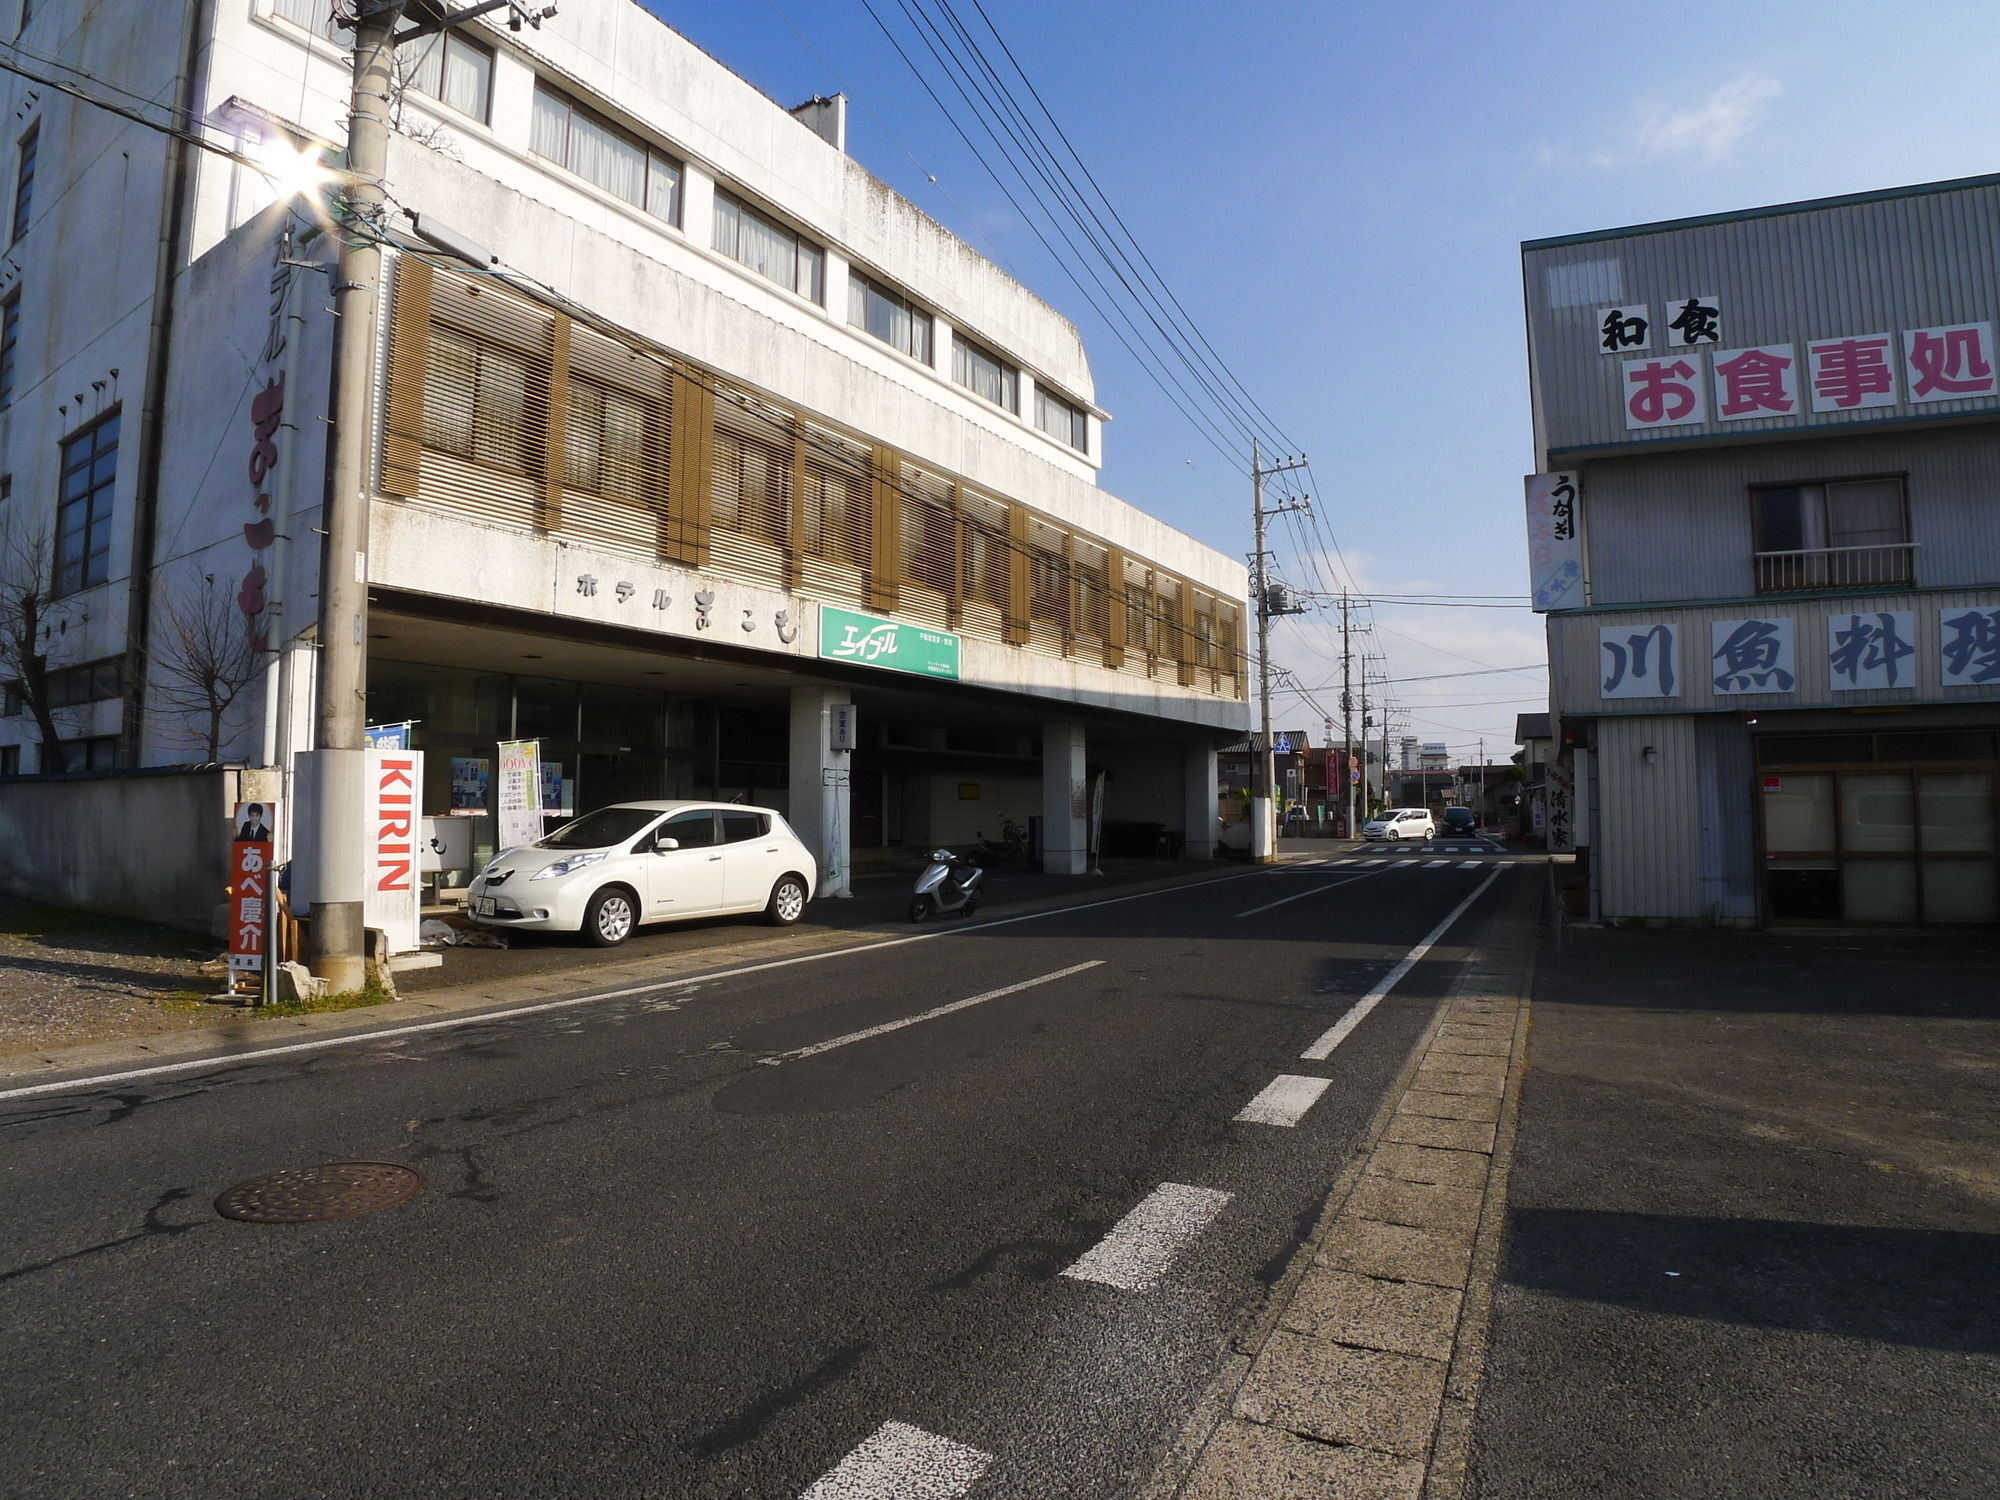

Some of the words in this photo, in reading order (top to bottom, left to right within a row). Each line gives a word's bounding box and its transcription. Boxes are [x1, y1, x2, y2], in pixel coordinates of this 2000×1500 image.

[1600, 298, 1719, 352] 和食
[1627, 328, 1994, 423] お食事処
[1551, 475, 1576, 541] うなぎ
[832, 624, 899, 660] エイブル
[1602, 611, 2000, 697] 川魚料理
[377, 759, 413, 892] KIRIN
[1550, 791, 1569, 848] 清水家
[239, 847, 264, 951] あべ慶介
